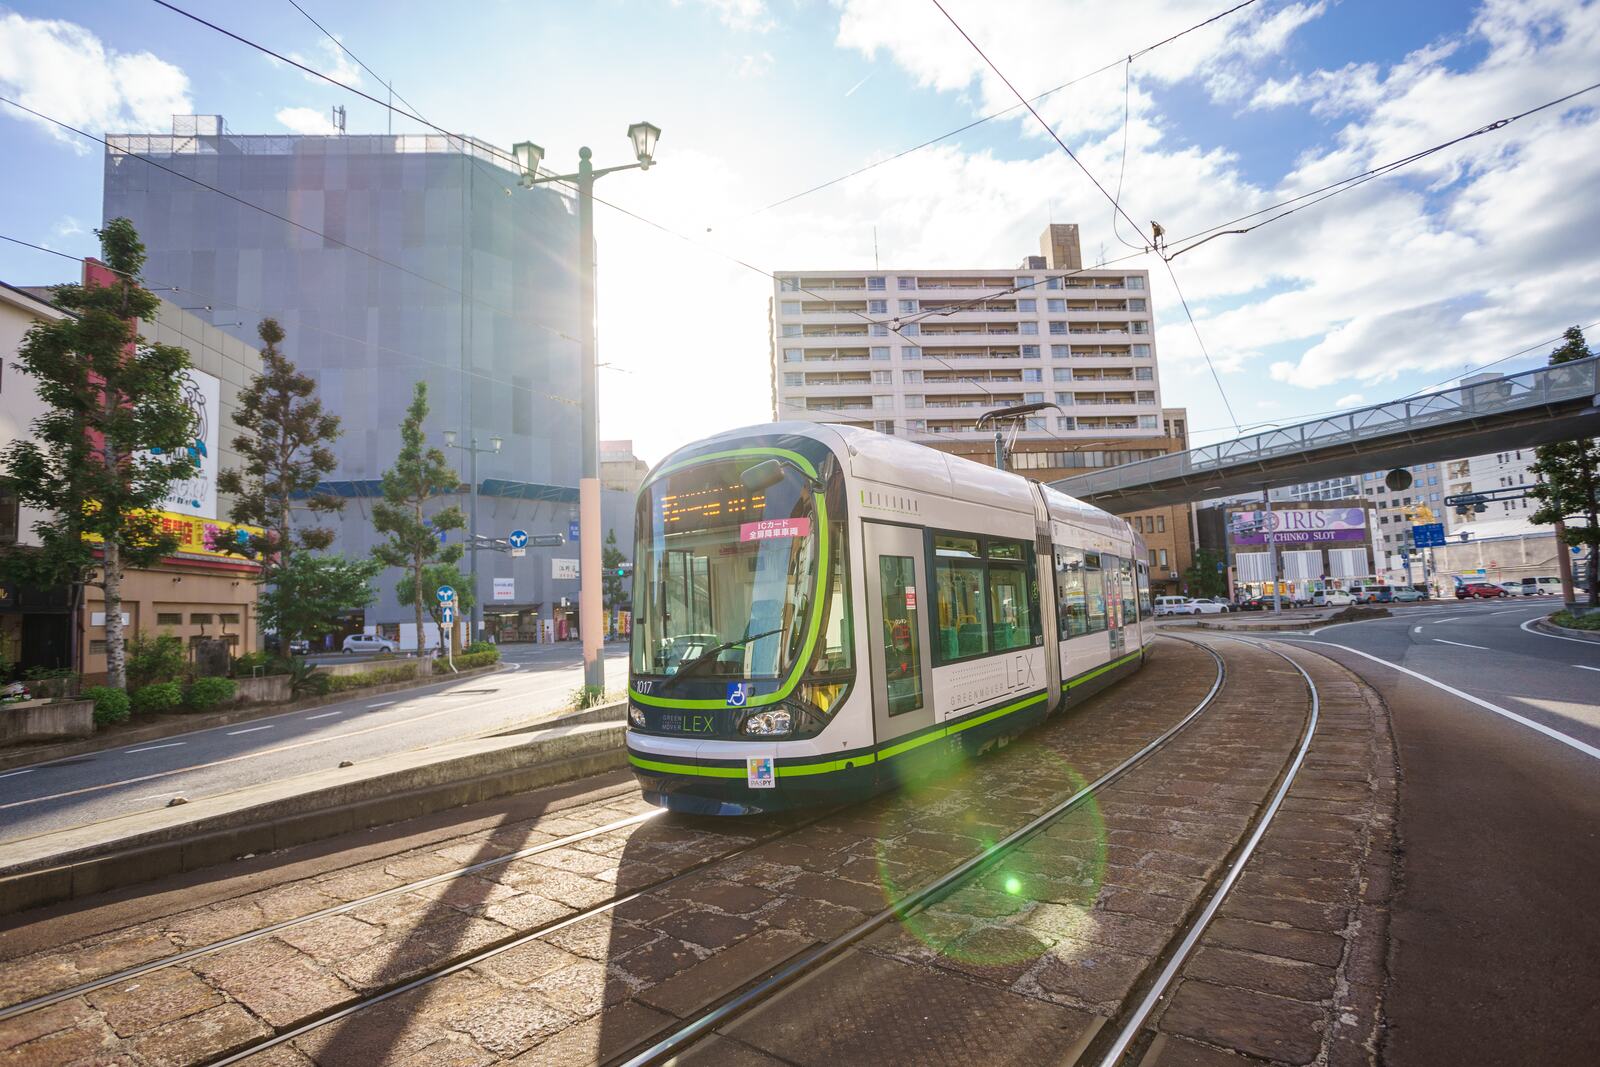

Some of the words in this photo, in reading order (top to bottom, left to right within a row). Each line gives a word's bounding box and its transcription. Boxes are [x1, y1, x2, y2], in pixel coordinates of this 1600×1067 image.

[757, 519, 789, 530] ICカード
[1284, 511, 1326, 529] IRIS
[1313, 530, 1336, 540] SLOT
[1005, 653, 1035, 689] LEX
[636, 681, 653, 694] 1017
[682, 715, 714, 733] LEX
